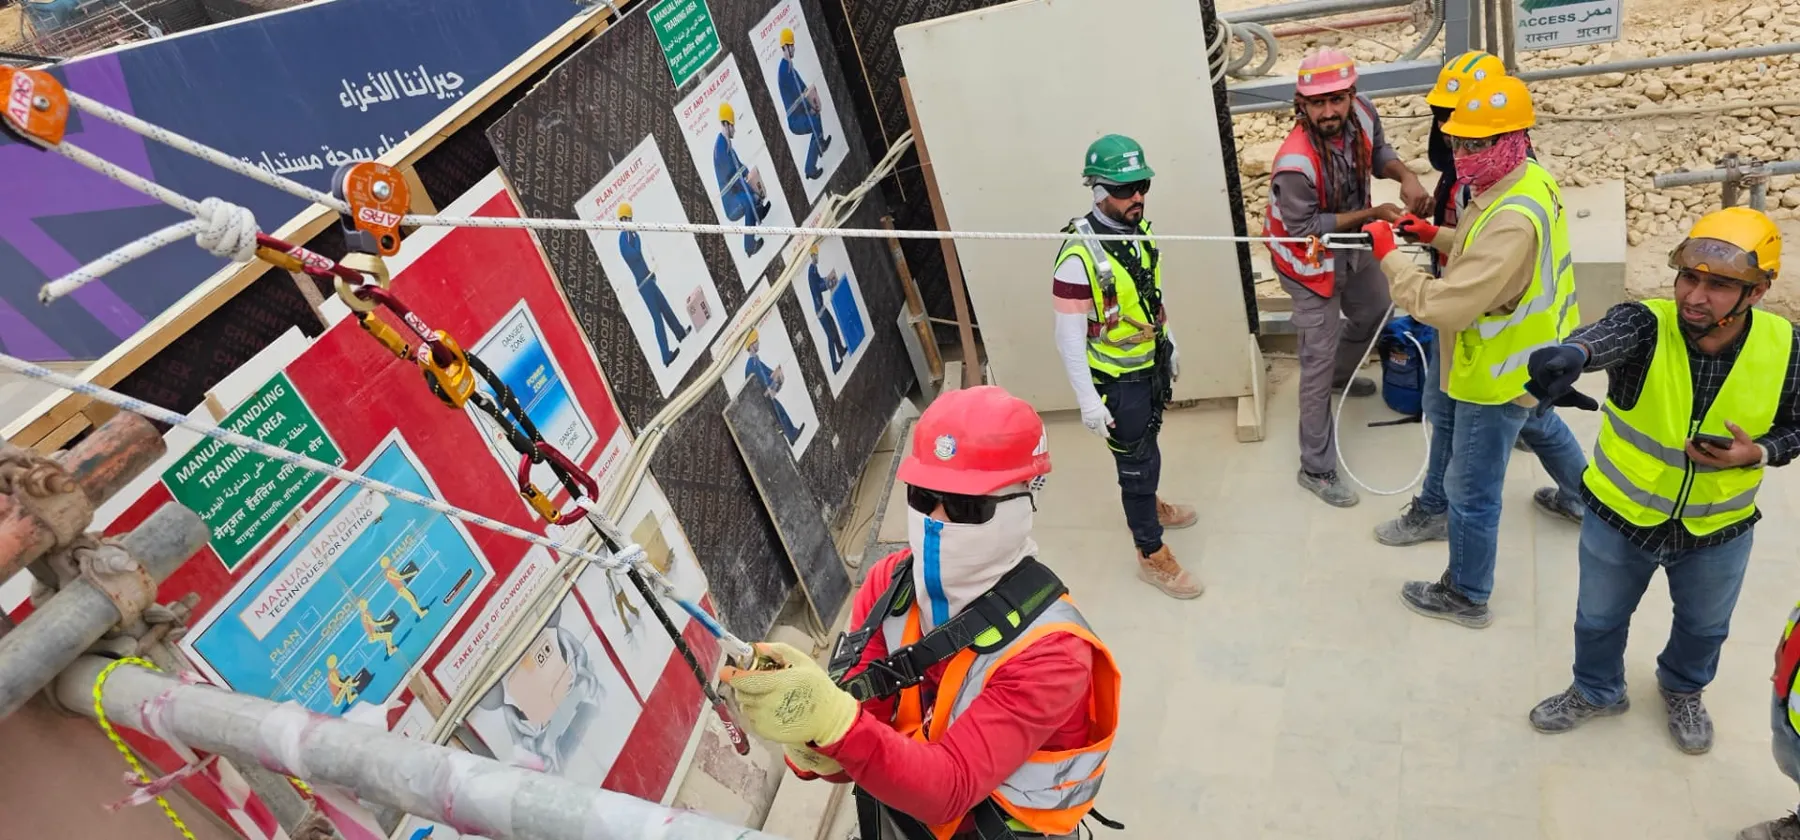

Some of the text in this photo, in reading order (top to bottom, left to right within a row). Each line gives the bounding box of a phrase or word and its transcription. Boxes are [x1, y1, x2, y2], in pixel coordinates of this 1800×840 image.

[1519, 13, 1576, 27] ACCESS
[1579, 7, 1612, 22] ممر
[1525, 31, 1558, 43] रास्ता
[11, 75, 30, 123] ARS
[339, 65, 464, 112] جيراننا الأعزاء
[683, 107, 693, 118] SIT
[693, 96, 704, 110] AND
[703, 84, 717, 98] TAKE
[594, 187, 613, 206] PLAN
[612, 170, 631, 189] YOUR
[630, 157, 645, 173] LIFT
[360, 207, 399, 227] ARS
[291, 248, 330, 269] ARS
[501, 322, 524, 347] DANGER
[510, 334, 526, 352] ZONE
[256, 411, 287, 441] AREA
[597, 447, 620, 480] MACHINE
[214, 508, 246, 540] मैनुअल
[254, 557, 311, 618] MANUAL
[311, 489, 376, 559] HANDLING
[268, 508, 373, 618] TECHNIQUES FOR LIFTING
[453, 646, 473, 670] TAKE
[473, 622, 490, 646] HELP
[490, 609, 501, 623] OF
[500, 562, 536, 610] CO-WORKER
[269, 629, 300, 662] PLAN
[298, 668, 321, 695] LEGS
